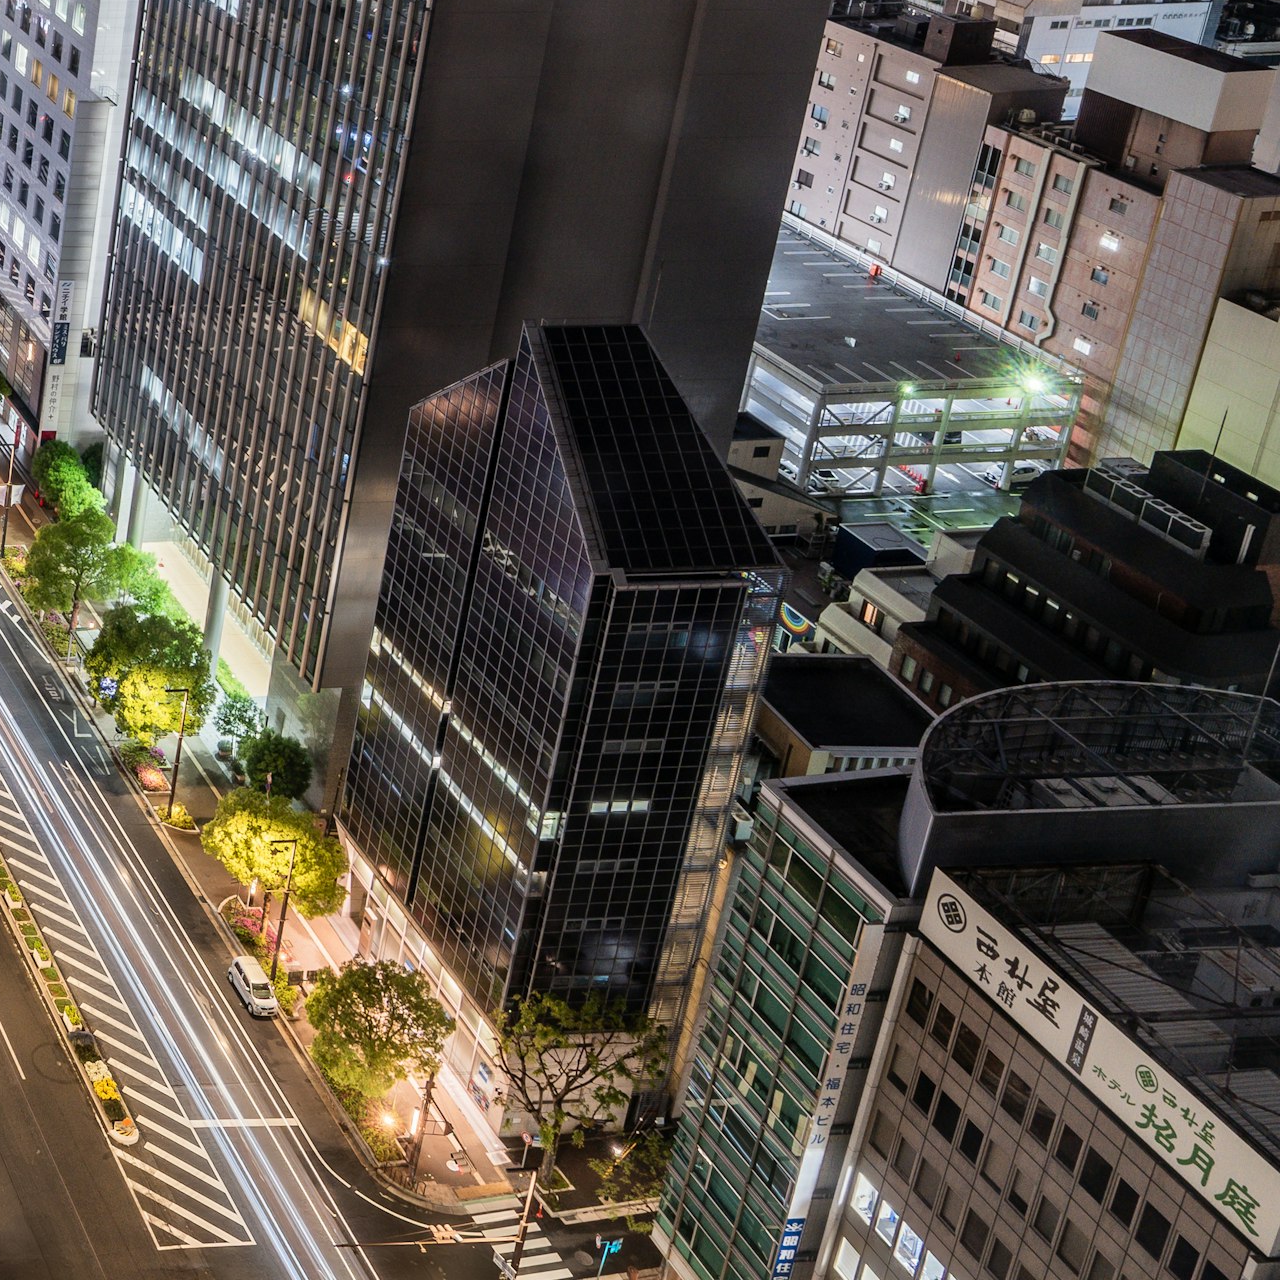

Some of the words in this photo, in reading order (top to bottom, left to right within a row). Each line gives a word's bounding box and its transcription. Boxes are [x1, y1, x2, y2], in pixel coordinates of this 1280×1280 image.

[58, 288, 71, 321] ニチイ学館
[52, 324, 60, 358] ダンディハウス
[973, 960, 1018, 1009] 本館
[976, 925, 1061, 1030] 西村屋
[810, 983, 867, 1145] 昭和住宅・福本ビル
[1071, 1010, 1094, 1068] 城崎温泉
[1092, 1064, 1136, 1106] ホテル
[1163, 1087, 1216, 1151] 西村屋
[1135, 1103, 1261, 1238] 招月庭
